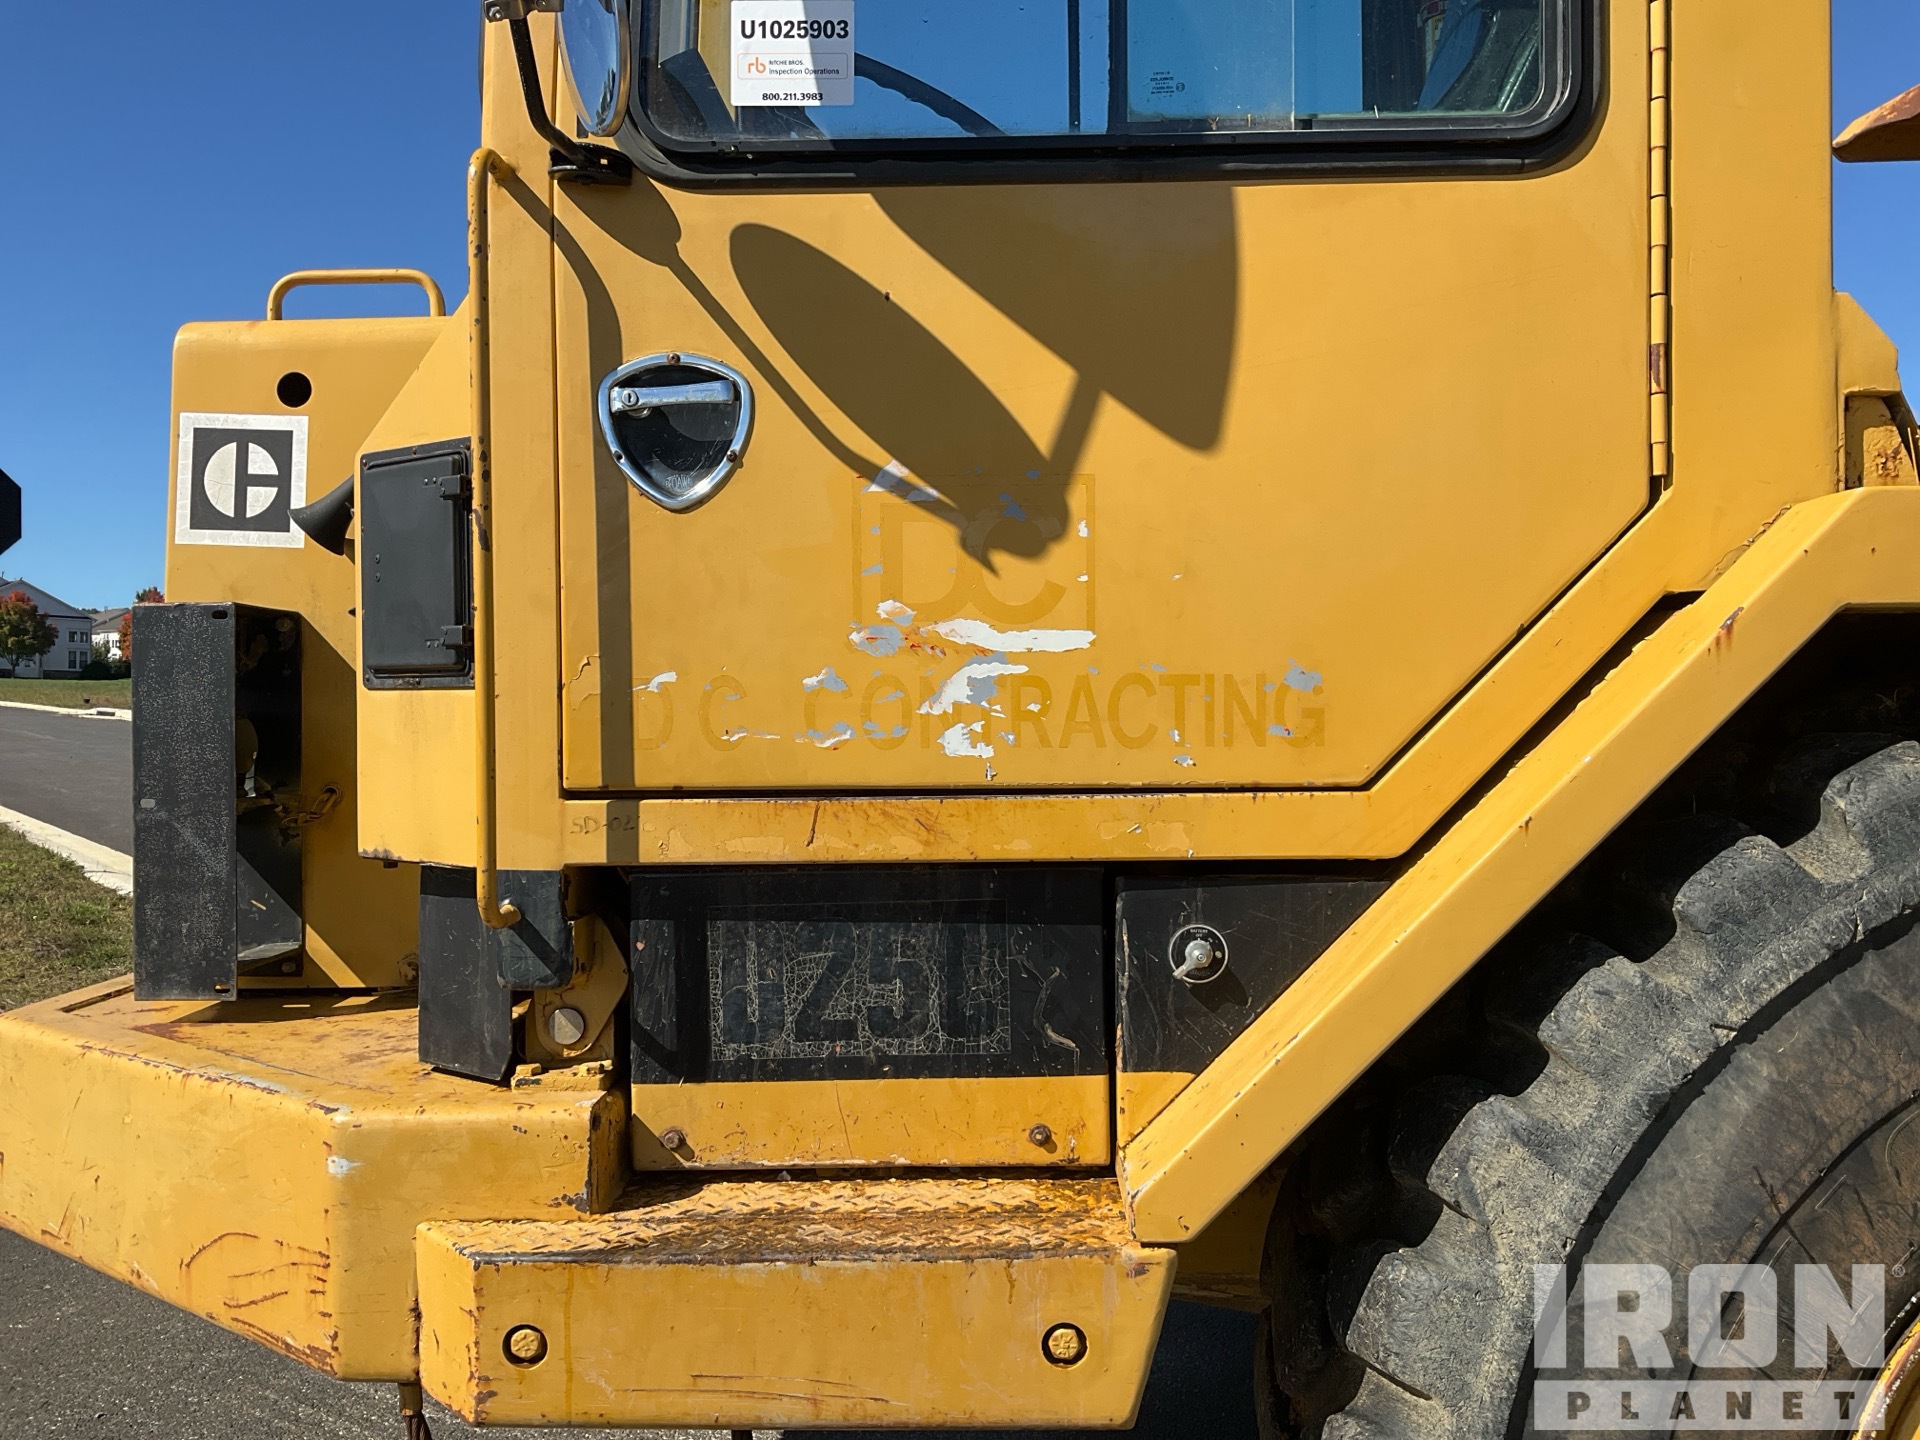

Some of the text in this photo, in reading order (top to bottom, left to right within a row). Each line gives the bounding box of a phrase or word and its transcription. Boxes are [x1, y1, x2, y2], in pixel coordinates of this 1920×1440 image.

[740, 20, 849, 39] U1025903
[769, 67, 840, 76] Inspection Operations
[762, 92, 824, 101] 800.211.3983
